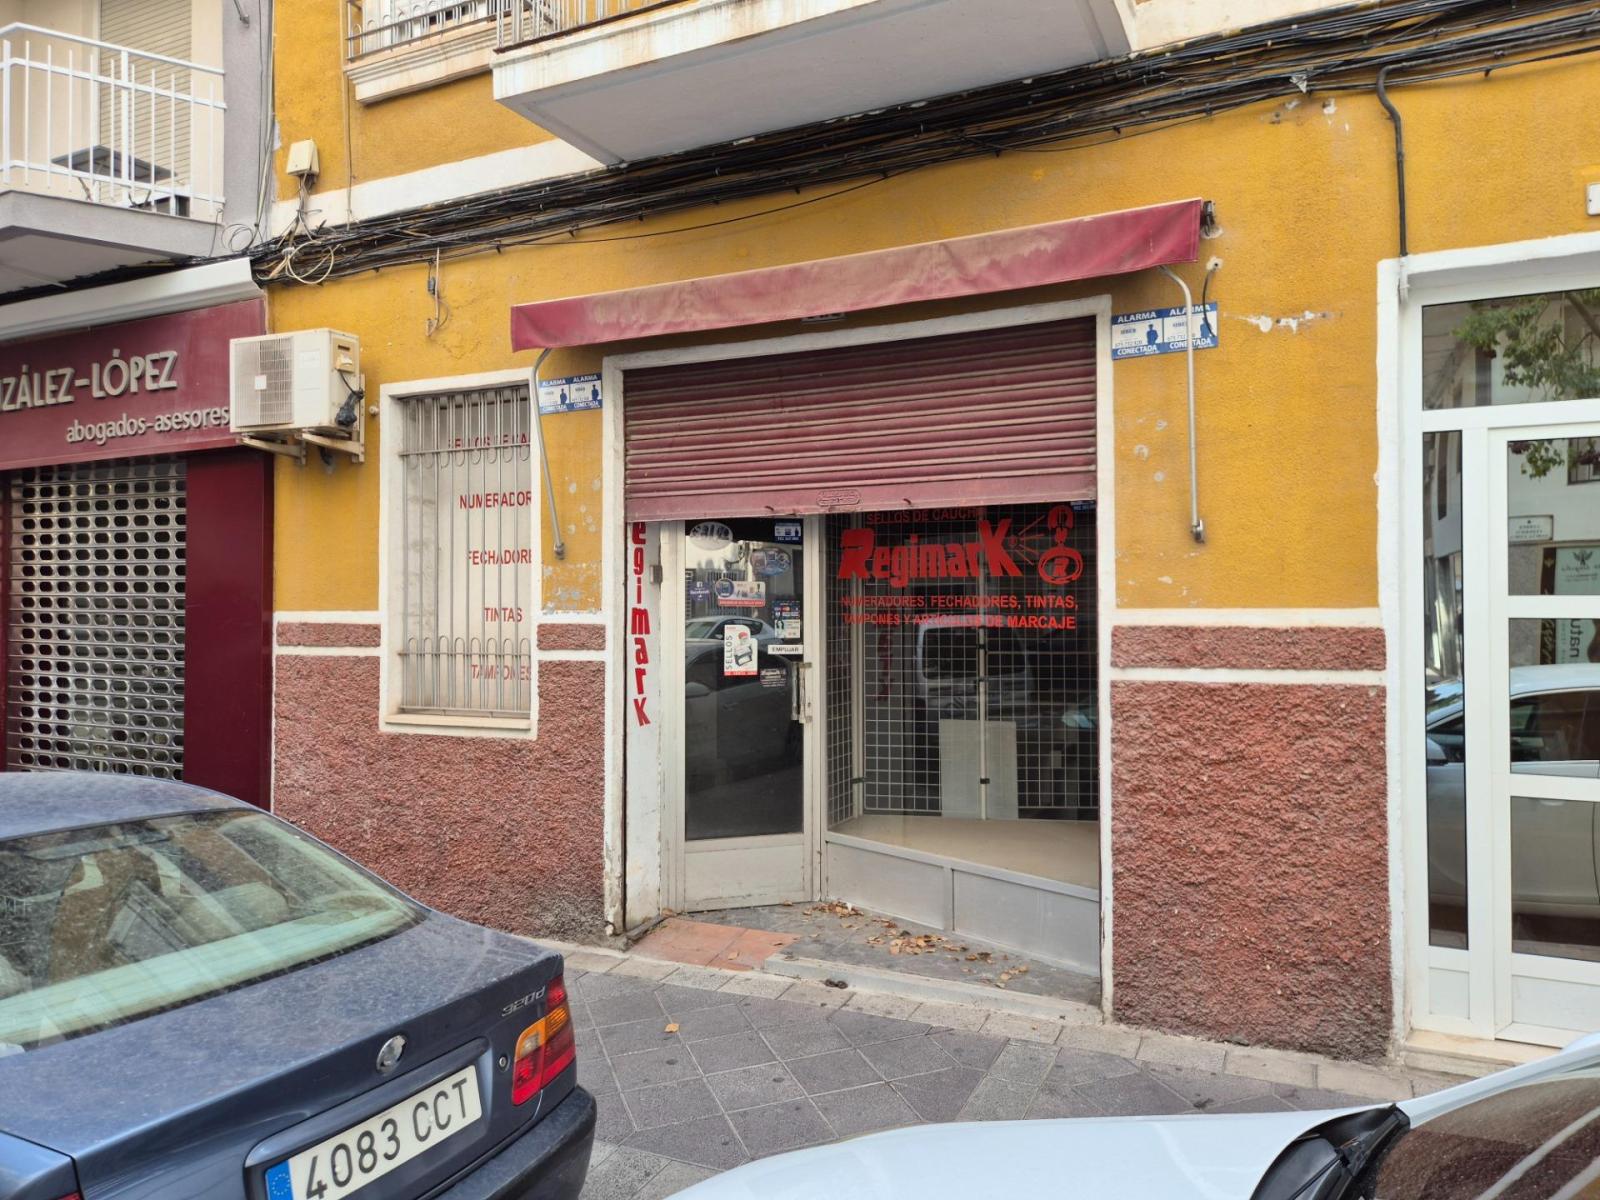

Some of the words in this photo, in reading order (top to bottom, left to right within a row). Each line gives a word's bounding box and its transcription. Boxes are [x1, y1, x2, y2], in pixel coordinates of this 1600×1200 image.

[1118, 312, 1157, 323] ALARMA
[1117, 345, 1158, 356] CONECTADA
[0, 348, 178, 411] ZÁLEZ-LÓPEZ
[66, 406, 230, 446] abogados-asesores
[867, 510, 911, 525] SELLOS
[913, 509, 929, 522] DE
[1025, 595, 1079, 610] TINTAS,
[484, 608, 523, 622] TINTAS
[1007, 615, 1076, 629] MARCAJE
[501, 985, 546, 1017] 320d
[306, 1118, 401, 1200] 4083
[412, 1078, 467, 1142] CCT
